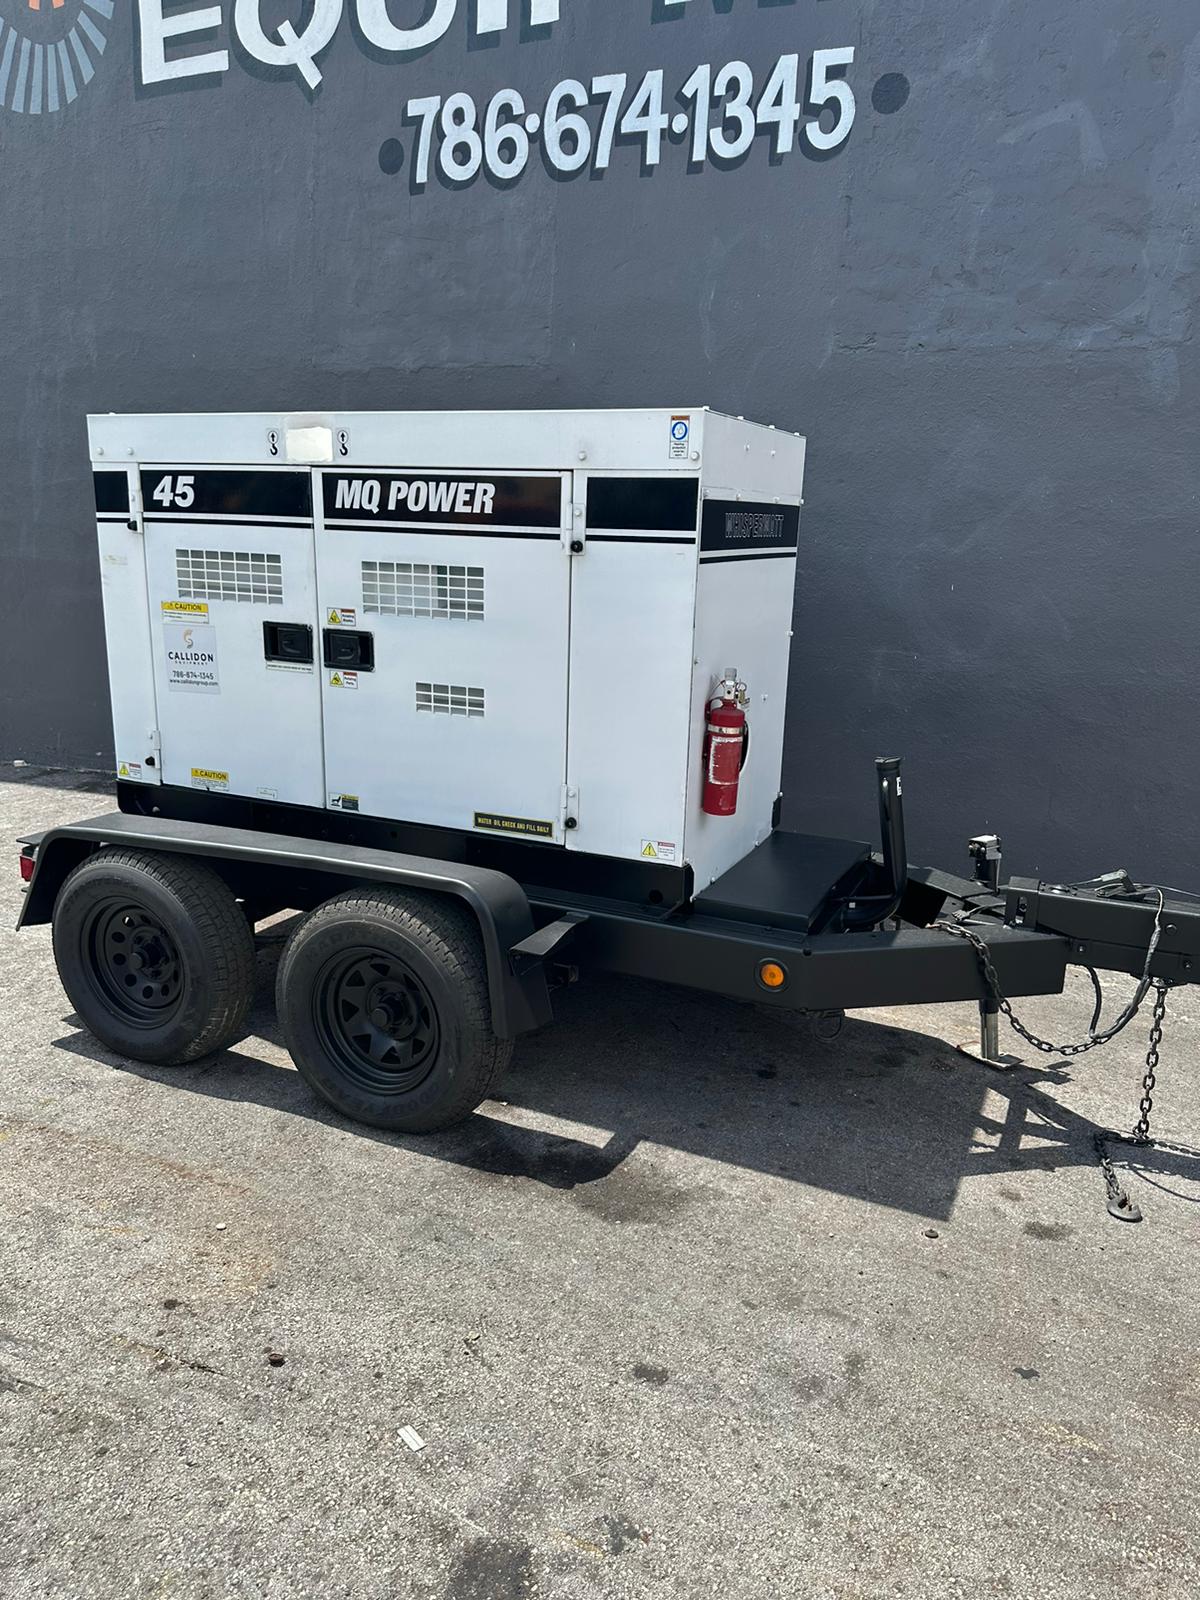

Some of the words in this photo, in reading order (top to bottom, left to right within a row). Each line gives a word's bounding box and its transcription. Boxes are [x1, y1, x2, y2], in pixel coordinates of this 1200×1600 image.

[152, 475, 195, 507] 45
[335, 479, 382, 514] MQ
[387, 480, 496, 514] POWER
[174, 602, 202, 611] CAUTION
[168, 651, 214, 662] CALLIDON
[199, 769, 227, 780] CAUTION
